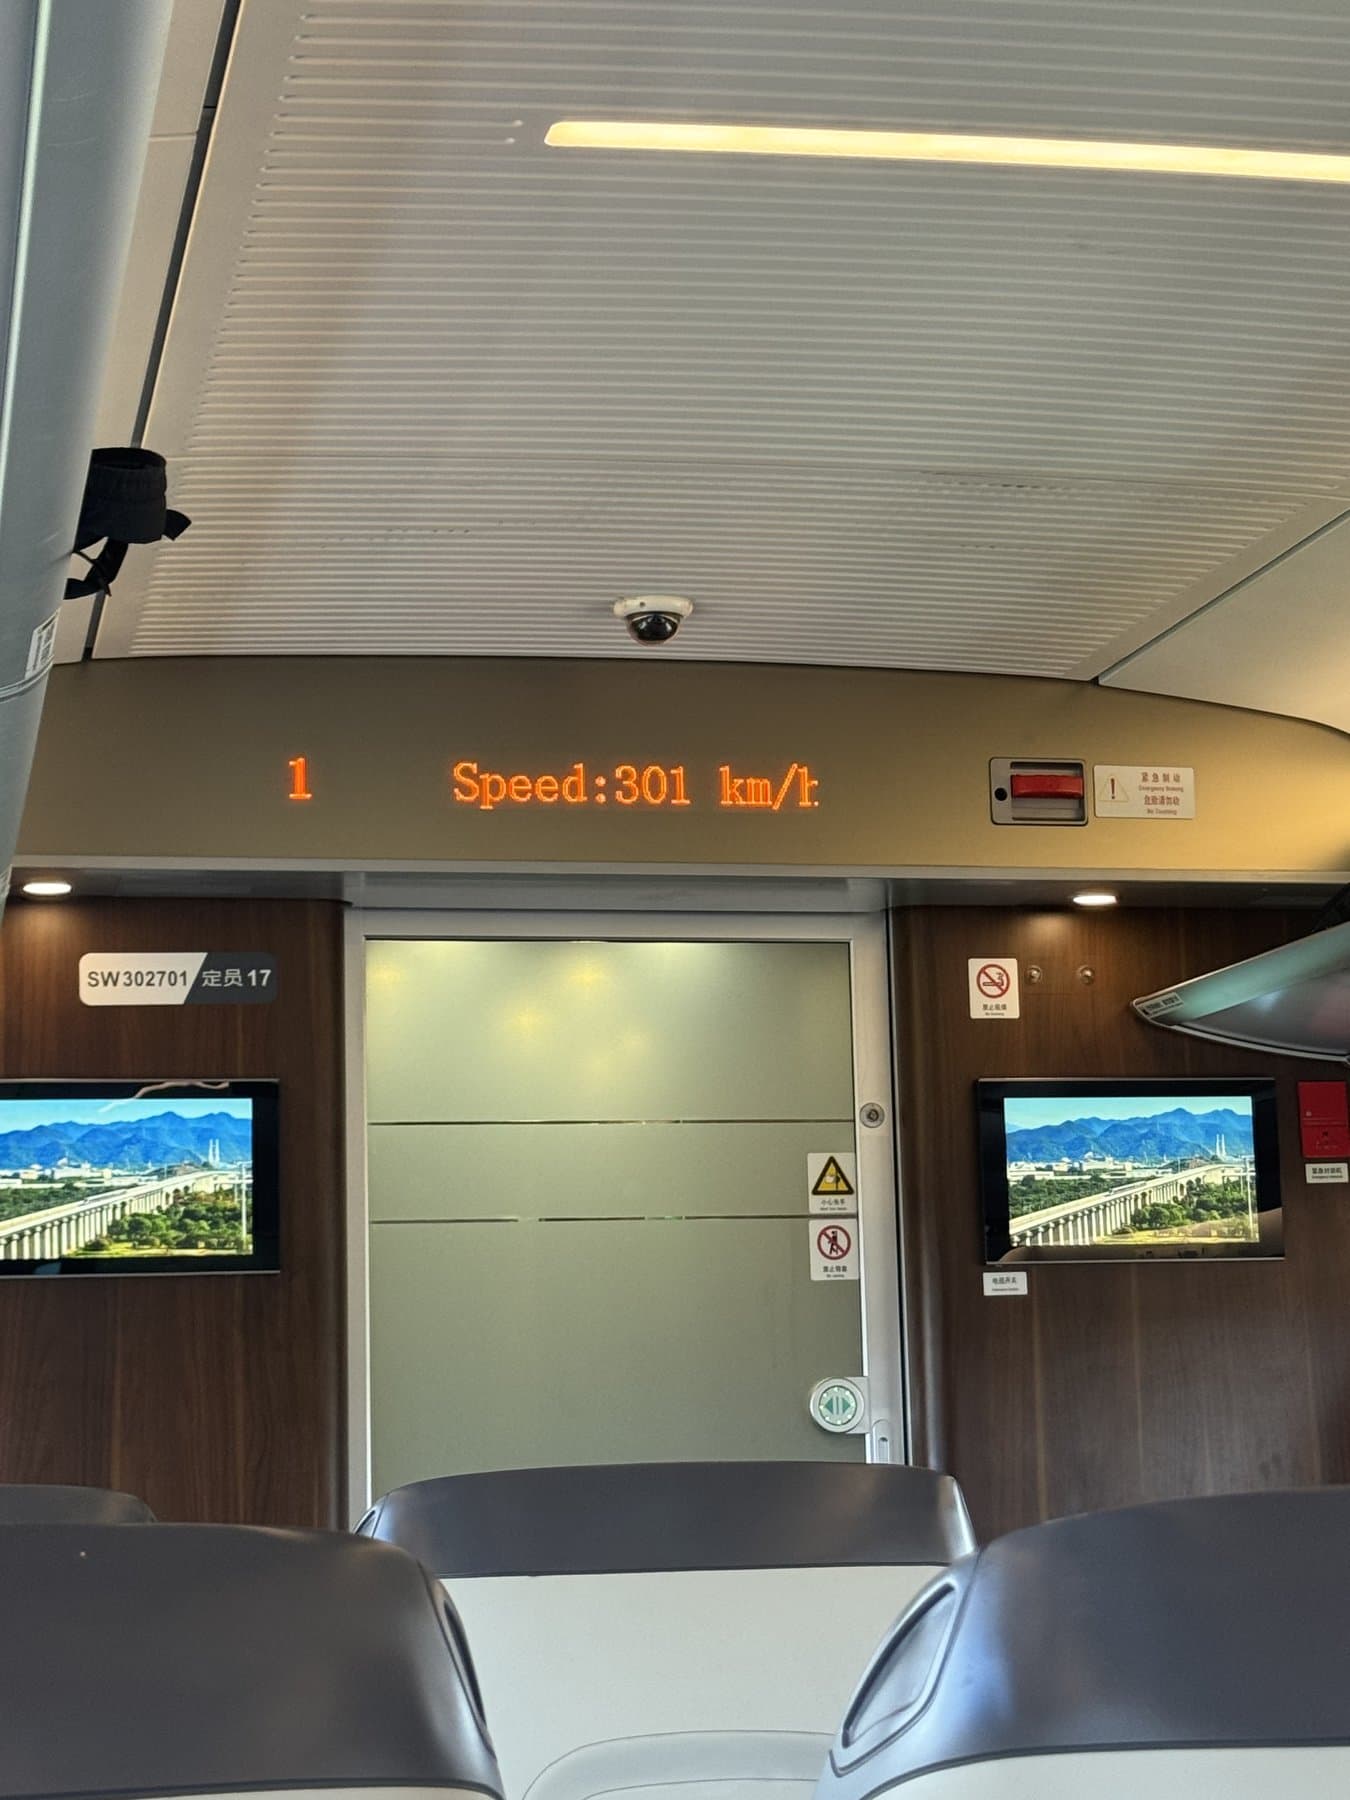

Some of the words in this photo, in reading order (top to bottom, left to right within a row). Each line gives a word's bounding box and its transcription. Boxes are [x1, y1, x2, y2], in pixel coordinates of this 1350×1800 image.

[289, 757, 312, 800] 1
[453, 762, 691, 810] Speed:301
[87, 970, 188, 988] SW302701
[202, 968, 243, 988] 定员
[247, 969, 272, 987] 17
